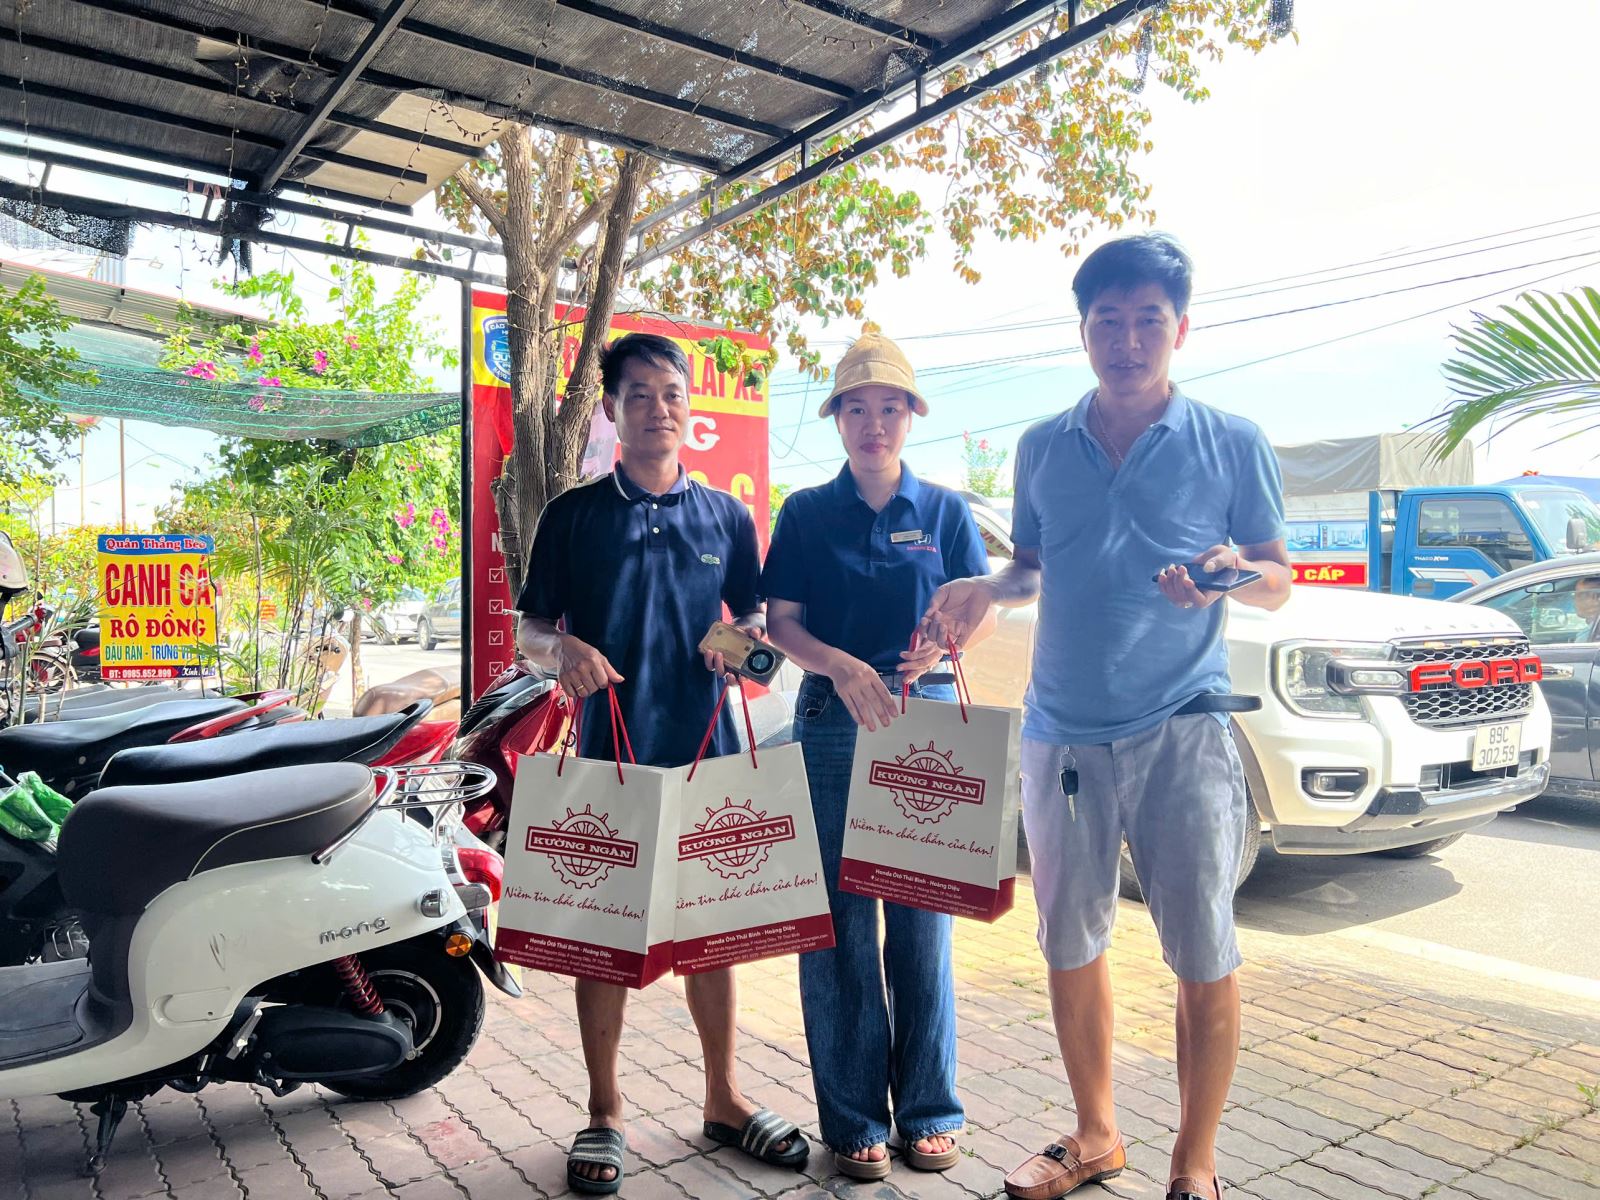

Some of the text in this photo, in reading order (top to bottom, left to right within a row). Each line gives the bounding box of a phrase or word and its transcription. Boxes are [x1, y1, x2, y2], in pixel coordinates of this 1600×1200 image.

[106, 537, 139, 551] Quán
[142, 536, 181, 551] Thắng
[105, 555, 211, 606] CANH CÁ
[1304, 565, 1345, 581] CẤP
[110, 609, 206, 638] RÔ ĐỒNG
[1407, 655, 1543, 692] FORD
[1489, 726, 1509, 745] 89C
[1479, 745, 1515, 767] 302.59
[877, 770, 977, 796] KƯỜNG NGÂN
[533, 836, 632, 859] KƯỜNG NGÂN
[680, 825, 787, 852] KƯỜNG NGÂN
[877, 824, 894, 834] tin
[896, 827, 919, 841] chắc
[920, 832, 945, 846] chắn
[947, 838, 967, 850] của
[533, 891, 550, 902] tin
[552, 893, 575, 907] chắc
[577, 897, 600, 911] chắn
[602, 903, 620, 915] của
[676, 897, 696, 909] iềm
[698, 894, 716, 906] tin
[719, 886, 742, 901] chắc
[745, 881, 770, 896] chắn
[773, 879, 792, 891] của
